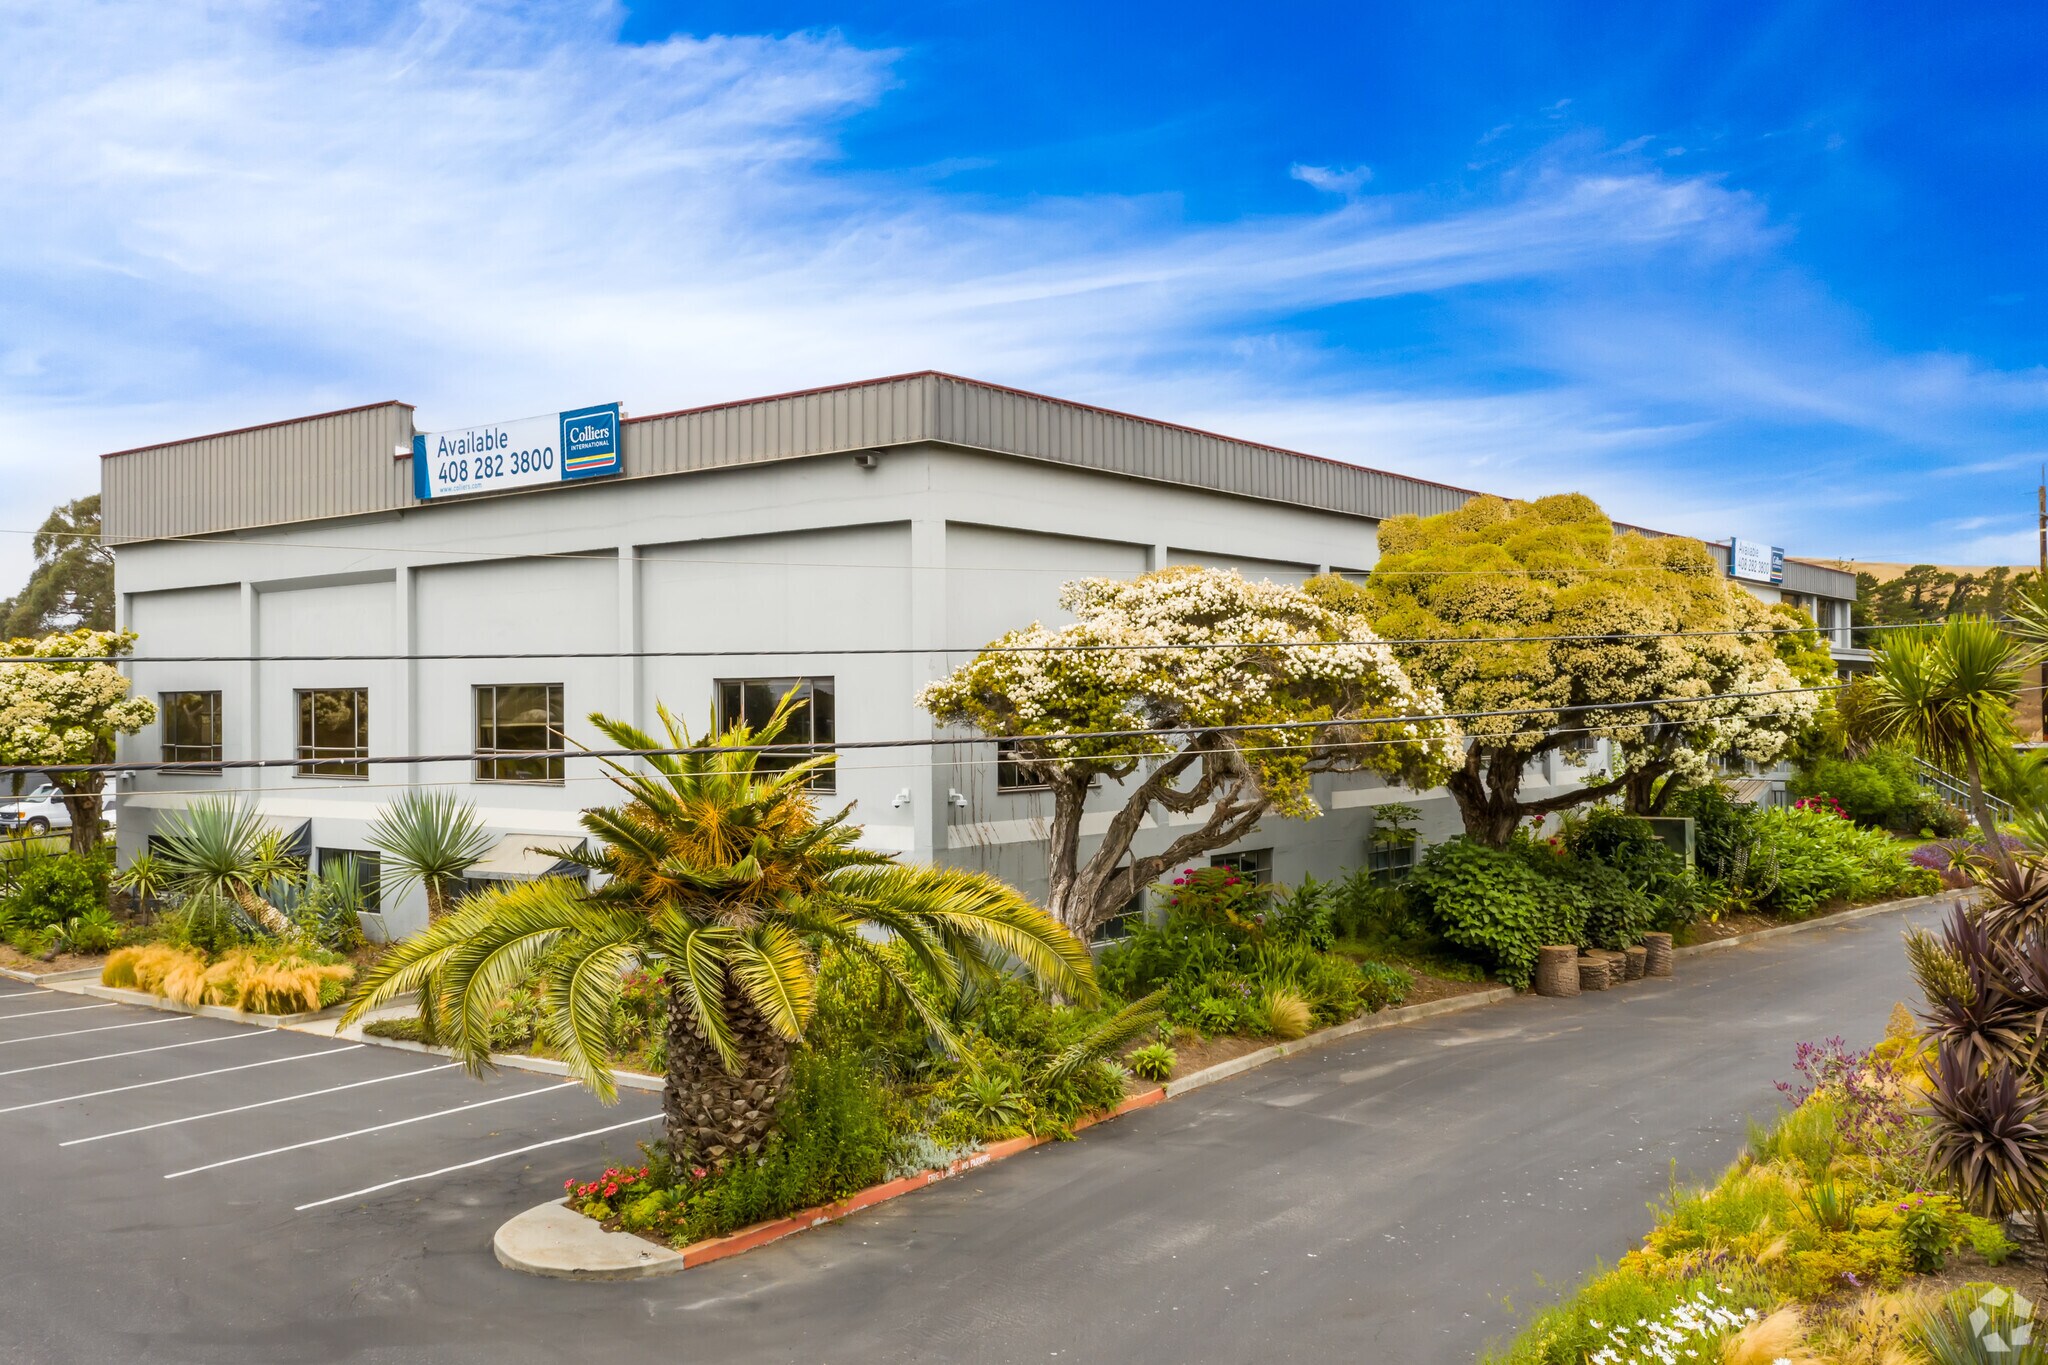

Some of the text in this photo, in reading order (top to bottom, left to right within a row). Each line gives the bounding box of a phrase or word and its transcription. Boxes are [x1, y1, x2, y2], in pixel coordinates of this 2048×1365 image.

[569, 425, 610, 443] Colliers
[437, 428, 508, 458] Available
[570, 440, 610, 451] INTERNATIONAL
[438, 446, 554, 484] 408 282 3800
[440, 482, 483, 493] www.colliers.com
[1738, 557, 1747, 571] 408
[1748, 559, 1757, 573] 282
[969, 1153, 991, 1168] PARKING
